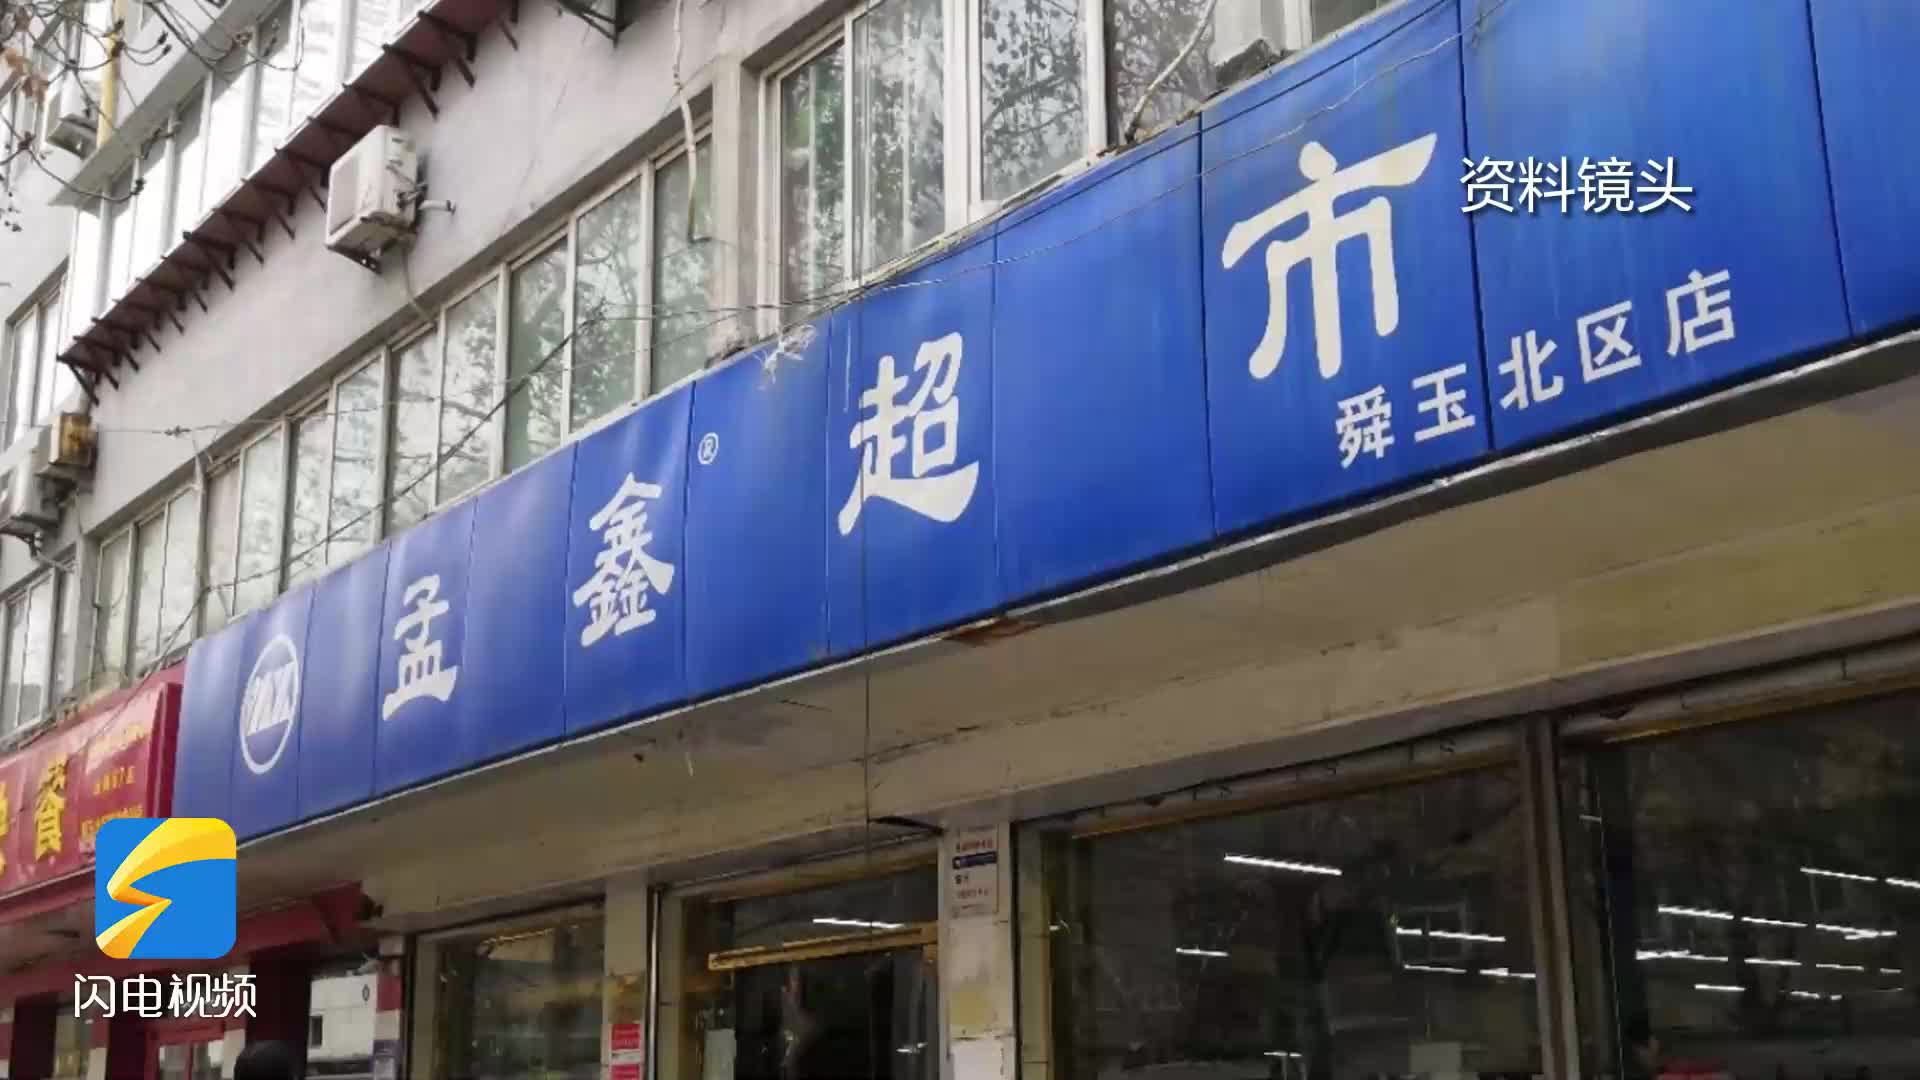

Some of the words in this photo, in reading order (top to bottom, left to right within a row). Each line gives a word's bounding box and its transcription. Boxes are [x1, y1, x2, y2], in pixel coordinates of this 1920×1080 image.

[383, 132, 1437, 721] 孟鑫超市
[1335, 269, 1736, 469] 舜玉北区店
